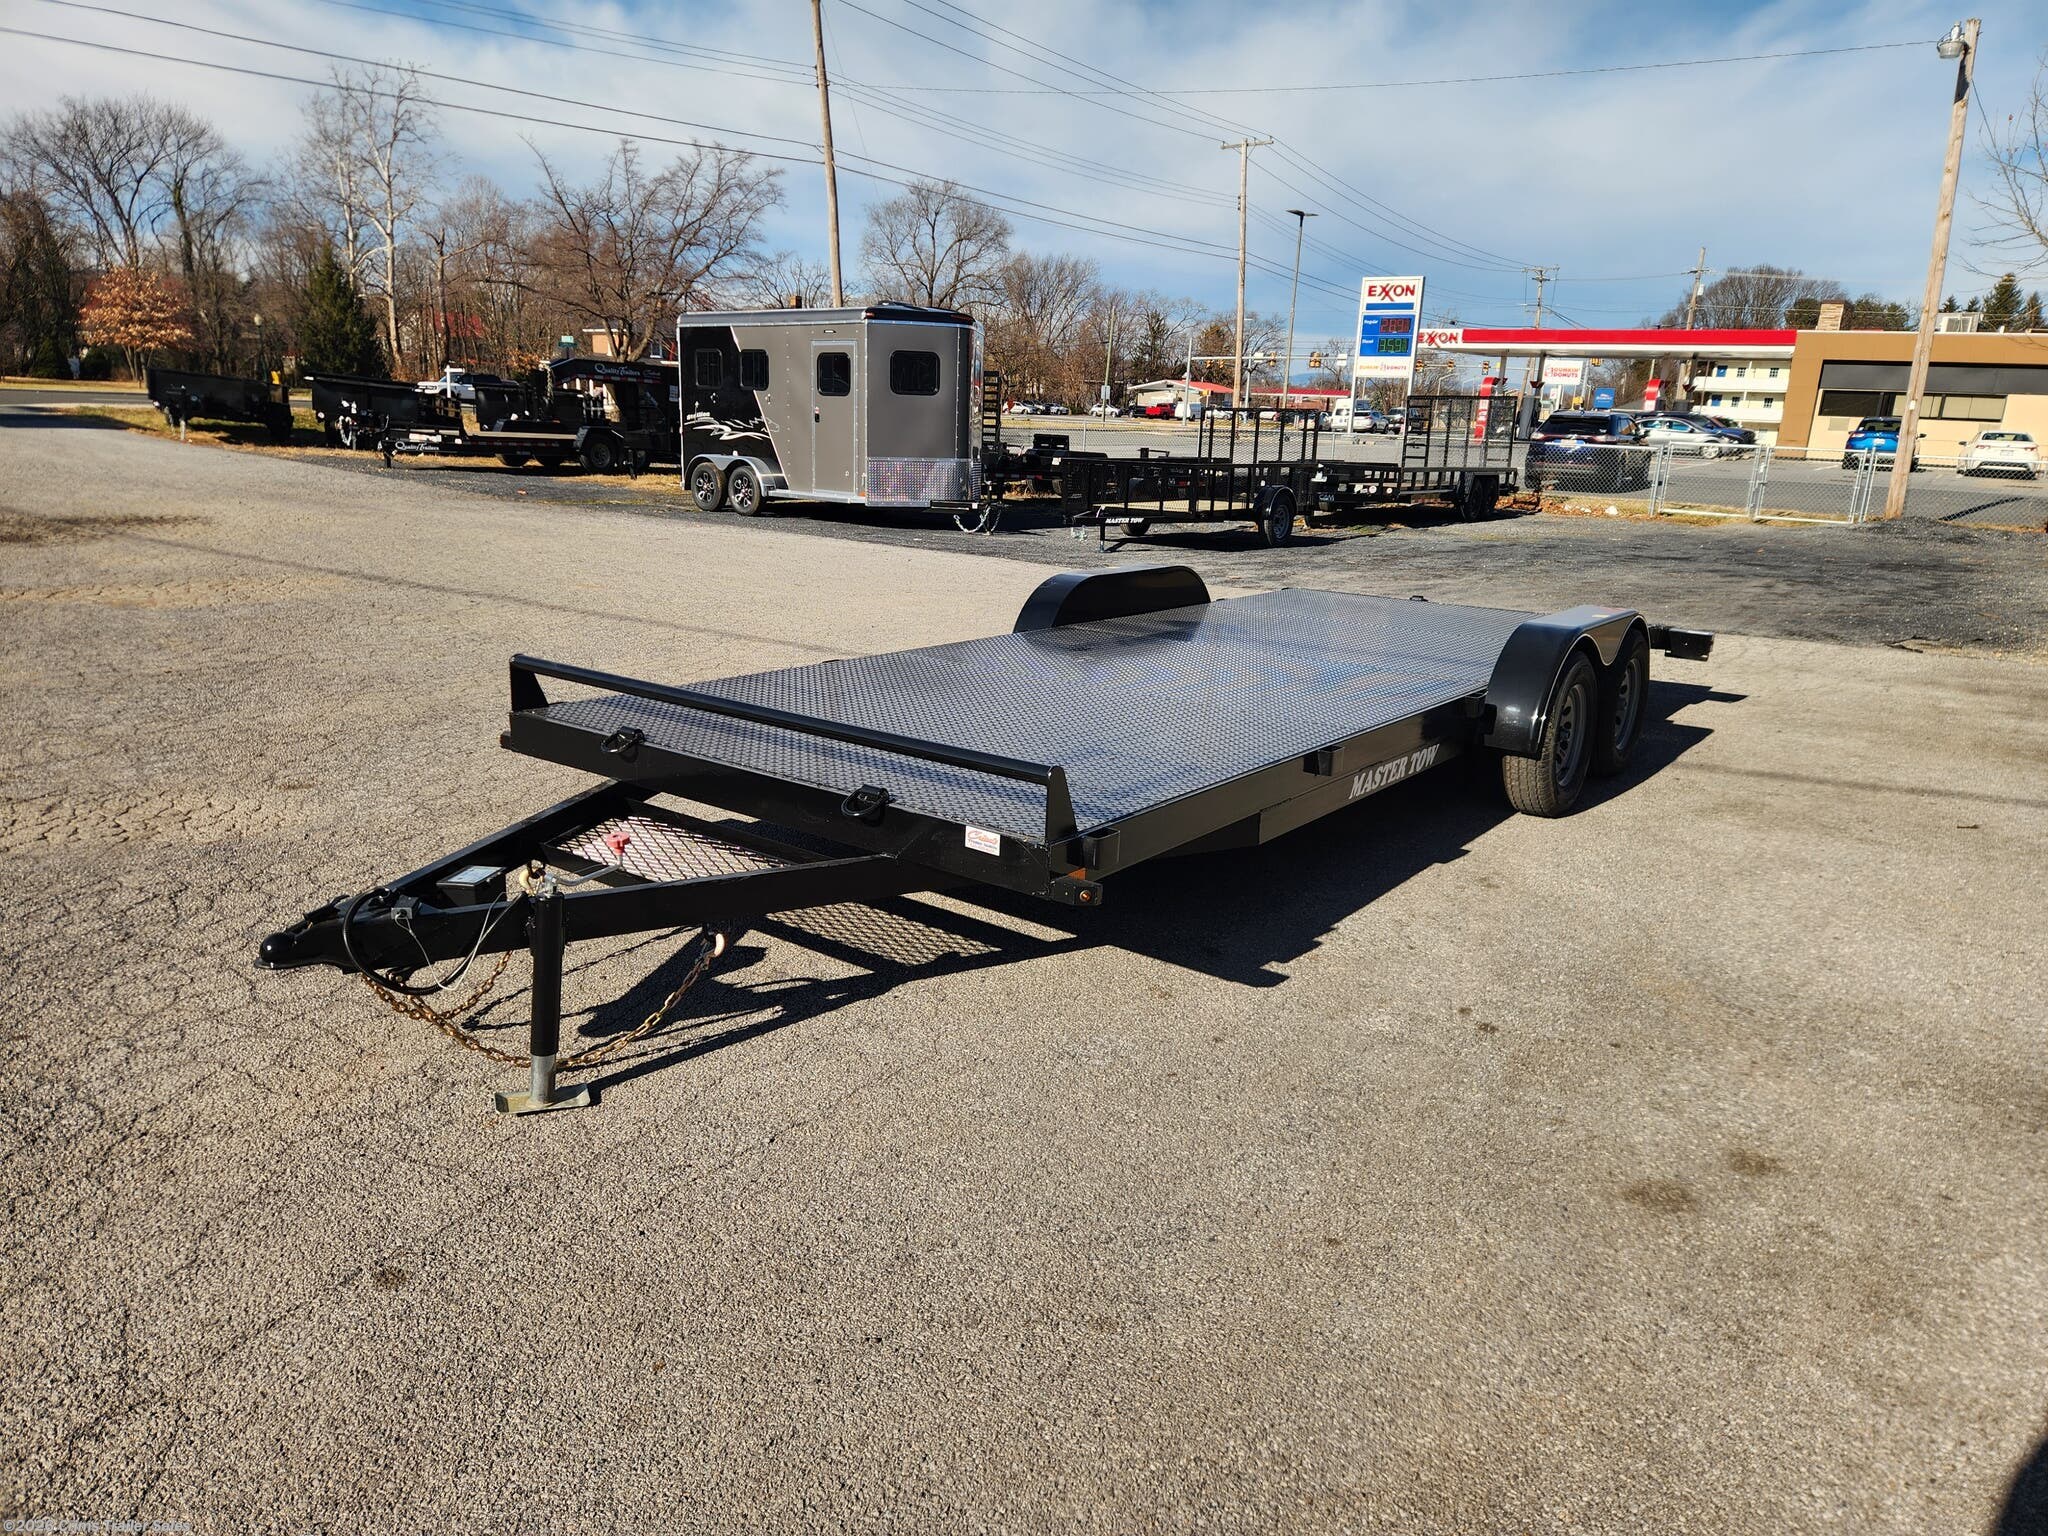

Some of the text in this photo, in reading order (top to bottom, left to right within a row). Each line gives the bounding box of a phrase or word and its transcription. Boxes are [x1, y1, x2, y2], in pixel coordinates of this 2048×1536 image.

[1367, 283, 1416, 302] EXXON
[1417, 330, 1460, 349] EXXON
[594, 363, 619, 375] Quality
[1348, 743, 1440, 799] MASTER TOW
